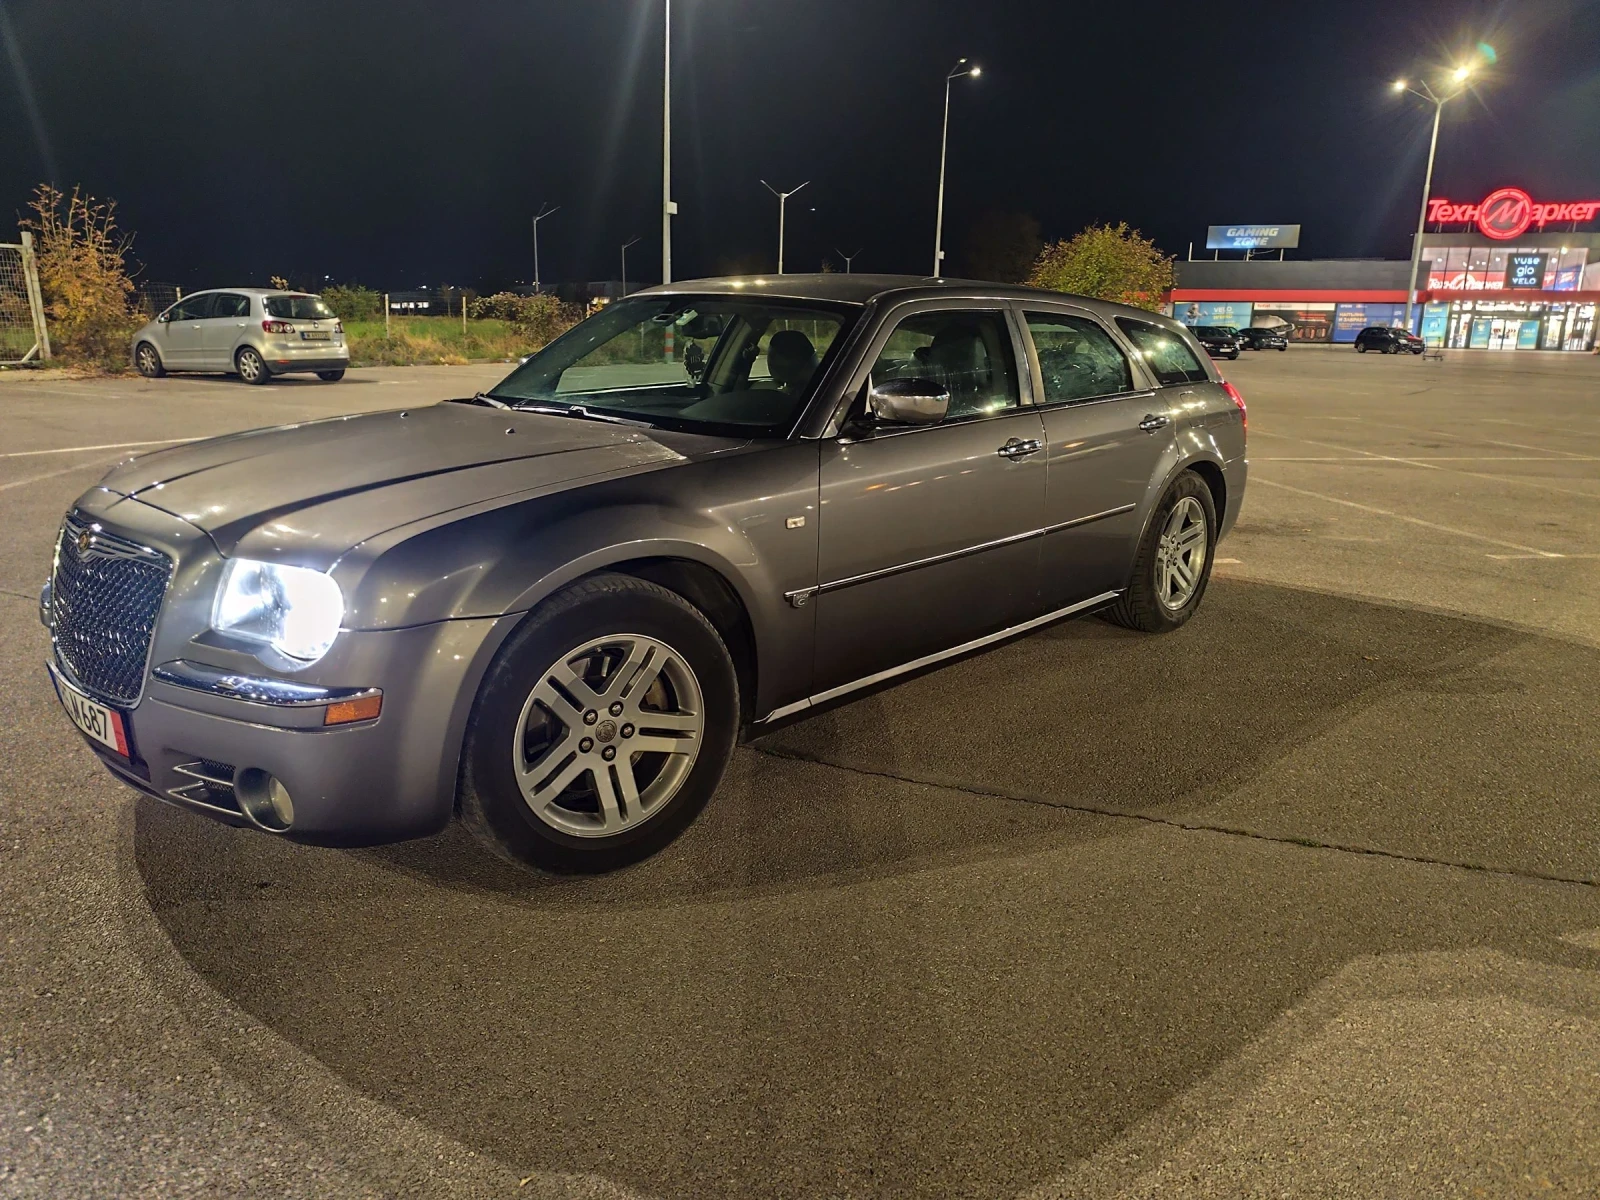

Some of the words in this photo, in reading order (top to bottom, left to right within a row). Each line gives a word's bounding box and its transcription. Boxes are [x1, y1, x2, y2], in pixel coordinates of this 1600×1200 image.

[1226, 227, 1279, 237] GAMING
[1233, 237, 1269, 246] ZONE
[1516, 265, 1535, 277] glo
[1512, 277, 1536, 285] VELO
